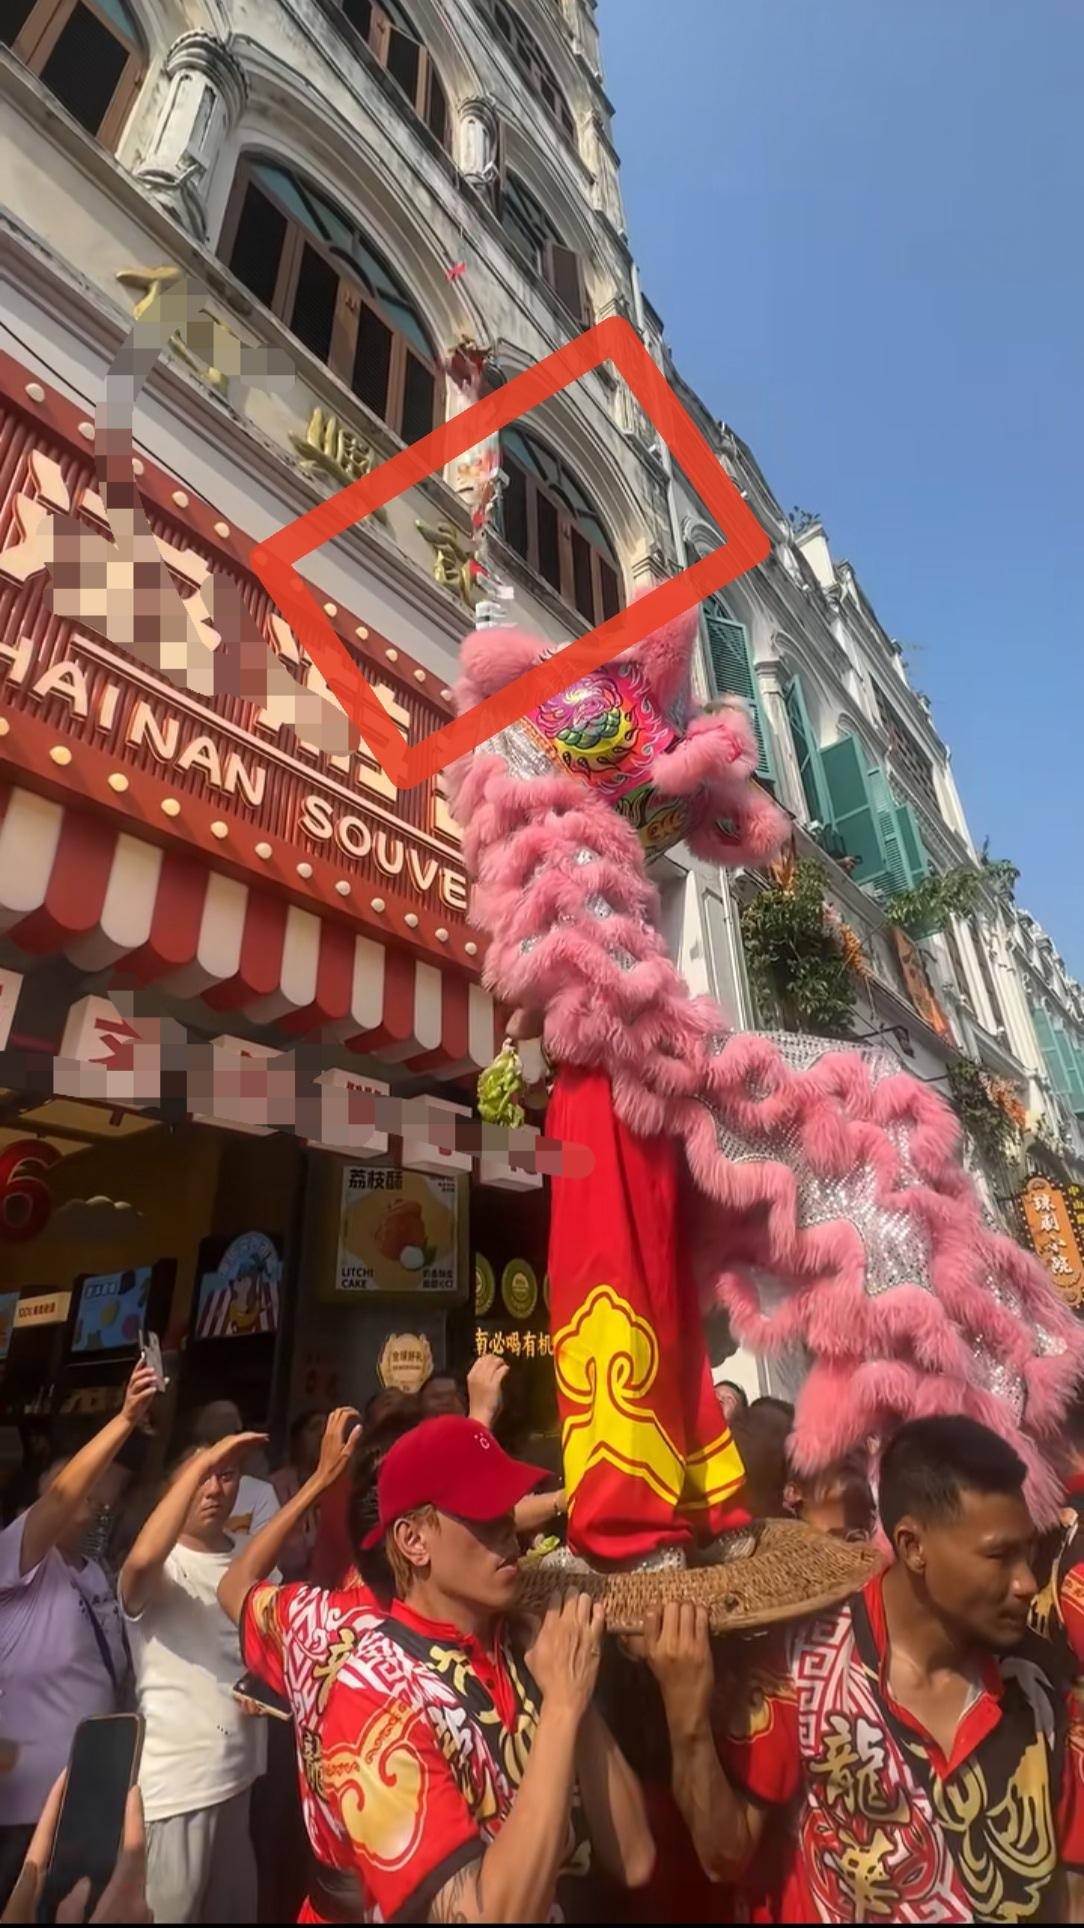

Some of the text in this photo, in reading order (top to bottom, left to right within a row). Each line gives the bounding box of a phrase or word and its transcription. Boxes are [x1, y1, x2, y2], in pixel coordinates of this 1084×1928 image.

[0, 636, 265, 807] HAINAN
[341, 1267, 374, 1278] LITCHI
[341, 1279, 367, 1289] CAKE
